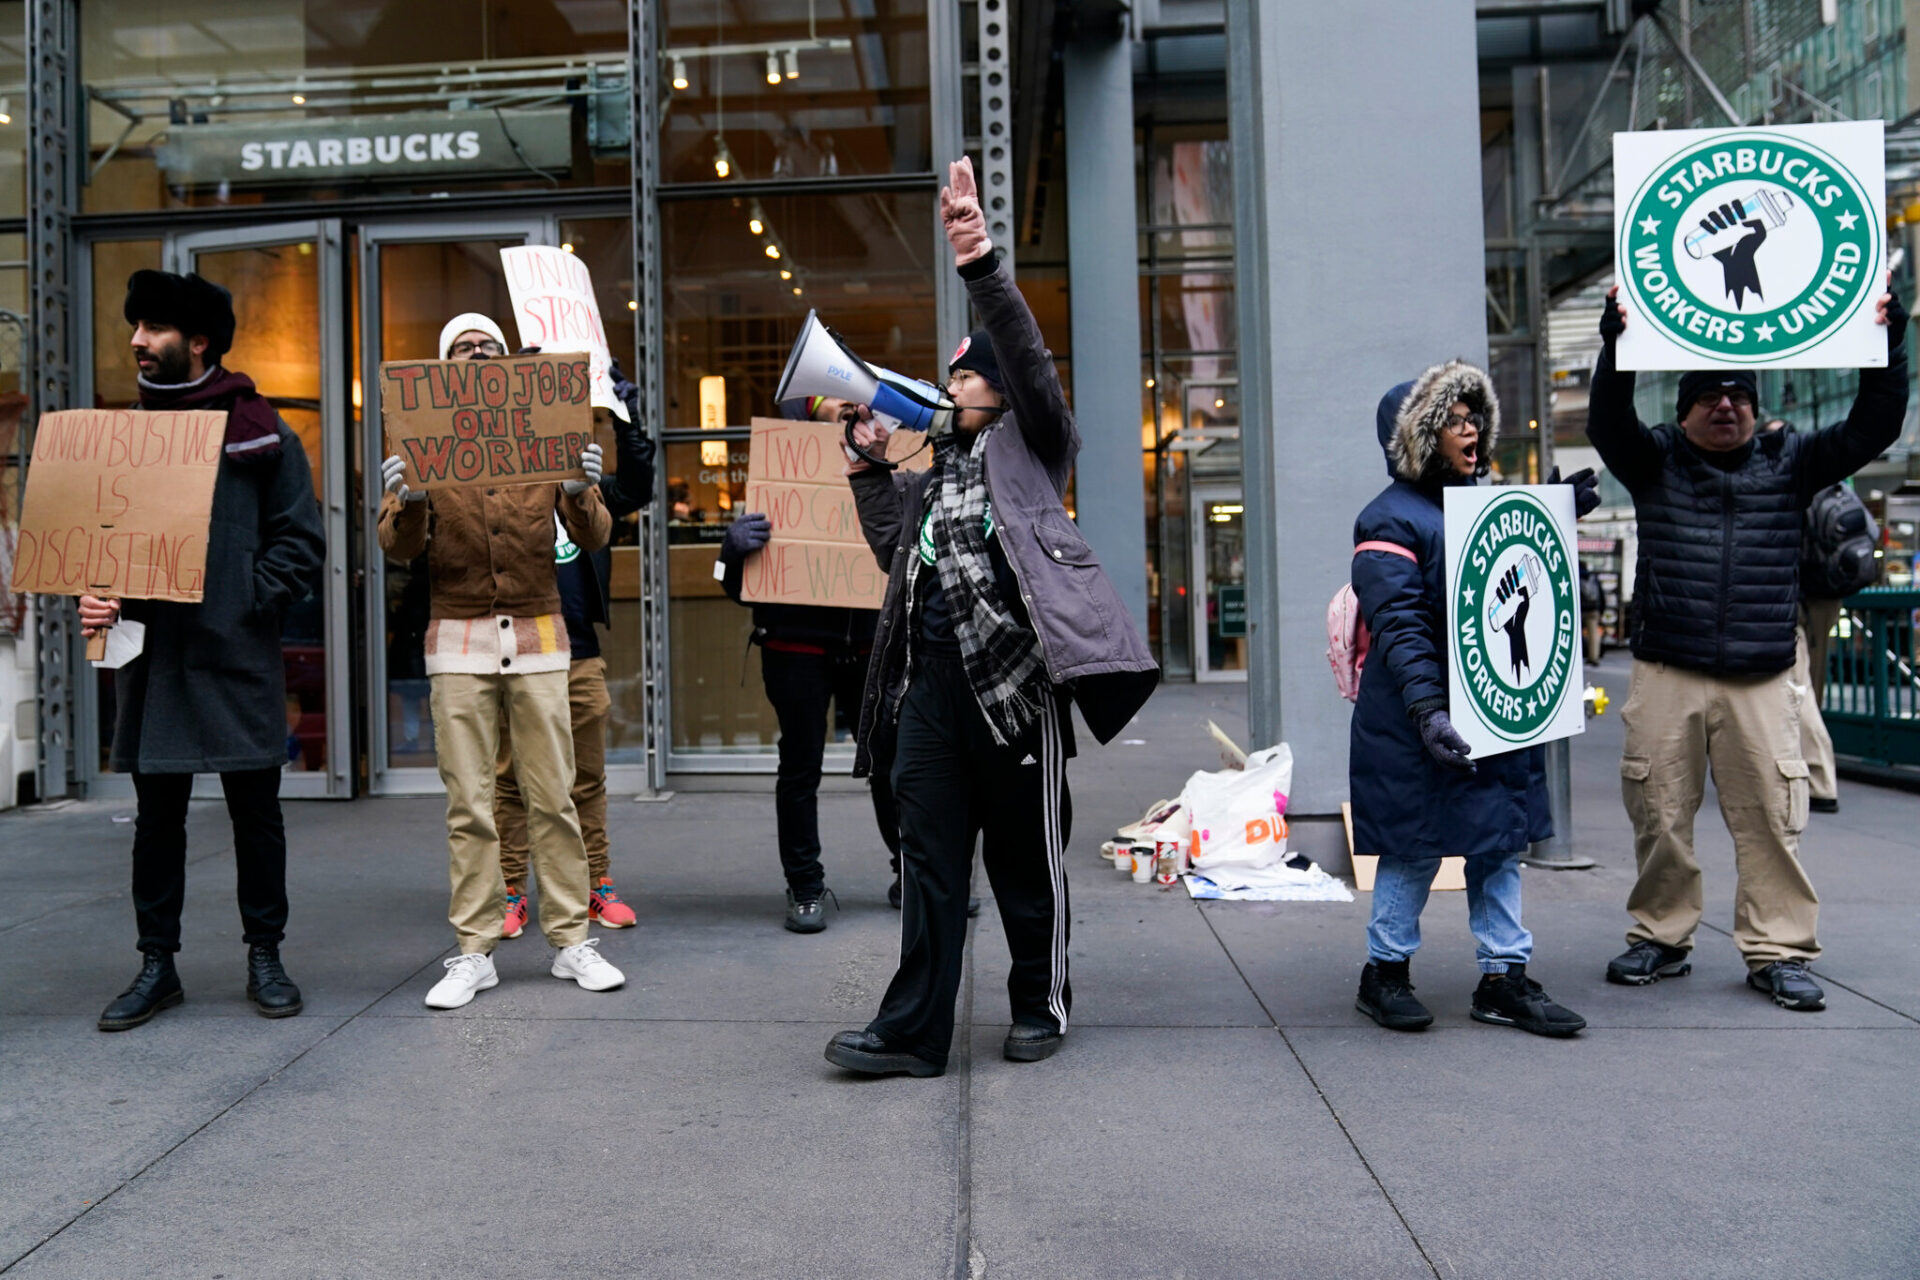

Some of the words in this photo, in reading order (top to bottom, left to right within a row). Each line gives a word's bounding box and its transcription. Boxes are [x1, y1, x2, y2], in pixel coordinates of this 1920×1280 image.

[241, 131, 480, 170] STARBUCKS
[1657, 148, 1843, 209] STARBUCKS
[508, 252, 592, 296] UNIO
[1634, 242, 1745, 344] WORKERS
[1777, 241, 1861, 335] UNITED
[523, 295, 611, 350] STRON
[386, 363, 508, 411] TWO
[513, 361, 590, 406] JOBS
[36, 413, 108, 462] UNION
[107, 411, 222, 468] BUSTING
[452, 408, 535, 440] ONE
[754, 426, 821, 480] TWO
[96, 474, 129, 518] IS
[750, 483, 803, 534] TWO
[810, 486, 861, 541] COM
[11, 526, 203, 597] DISGUSTING
[745, 542, 801, 598] ONE
[1472, 509, 1562, 575] STARBUCKS
[1461, 616, 1522, 722] WORKERS
[1536, 609, 1572, 708] UNITED
